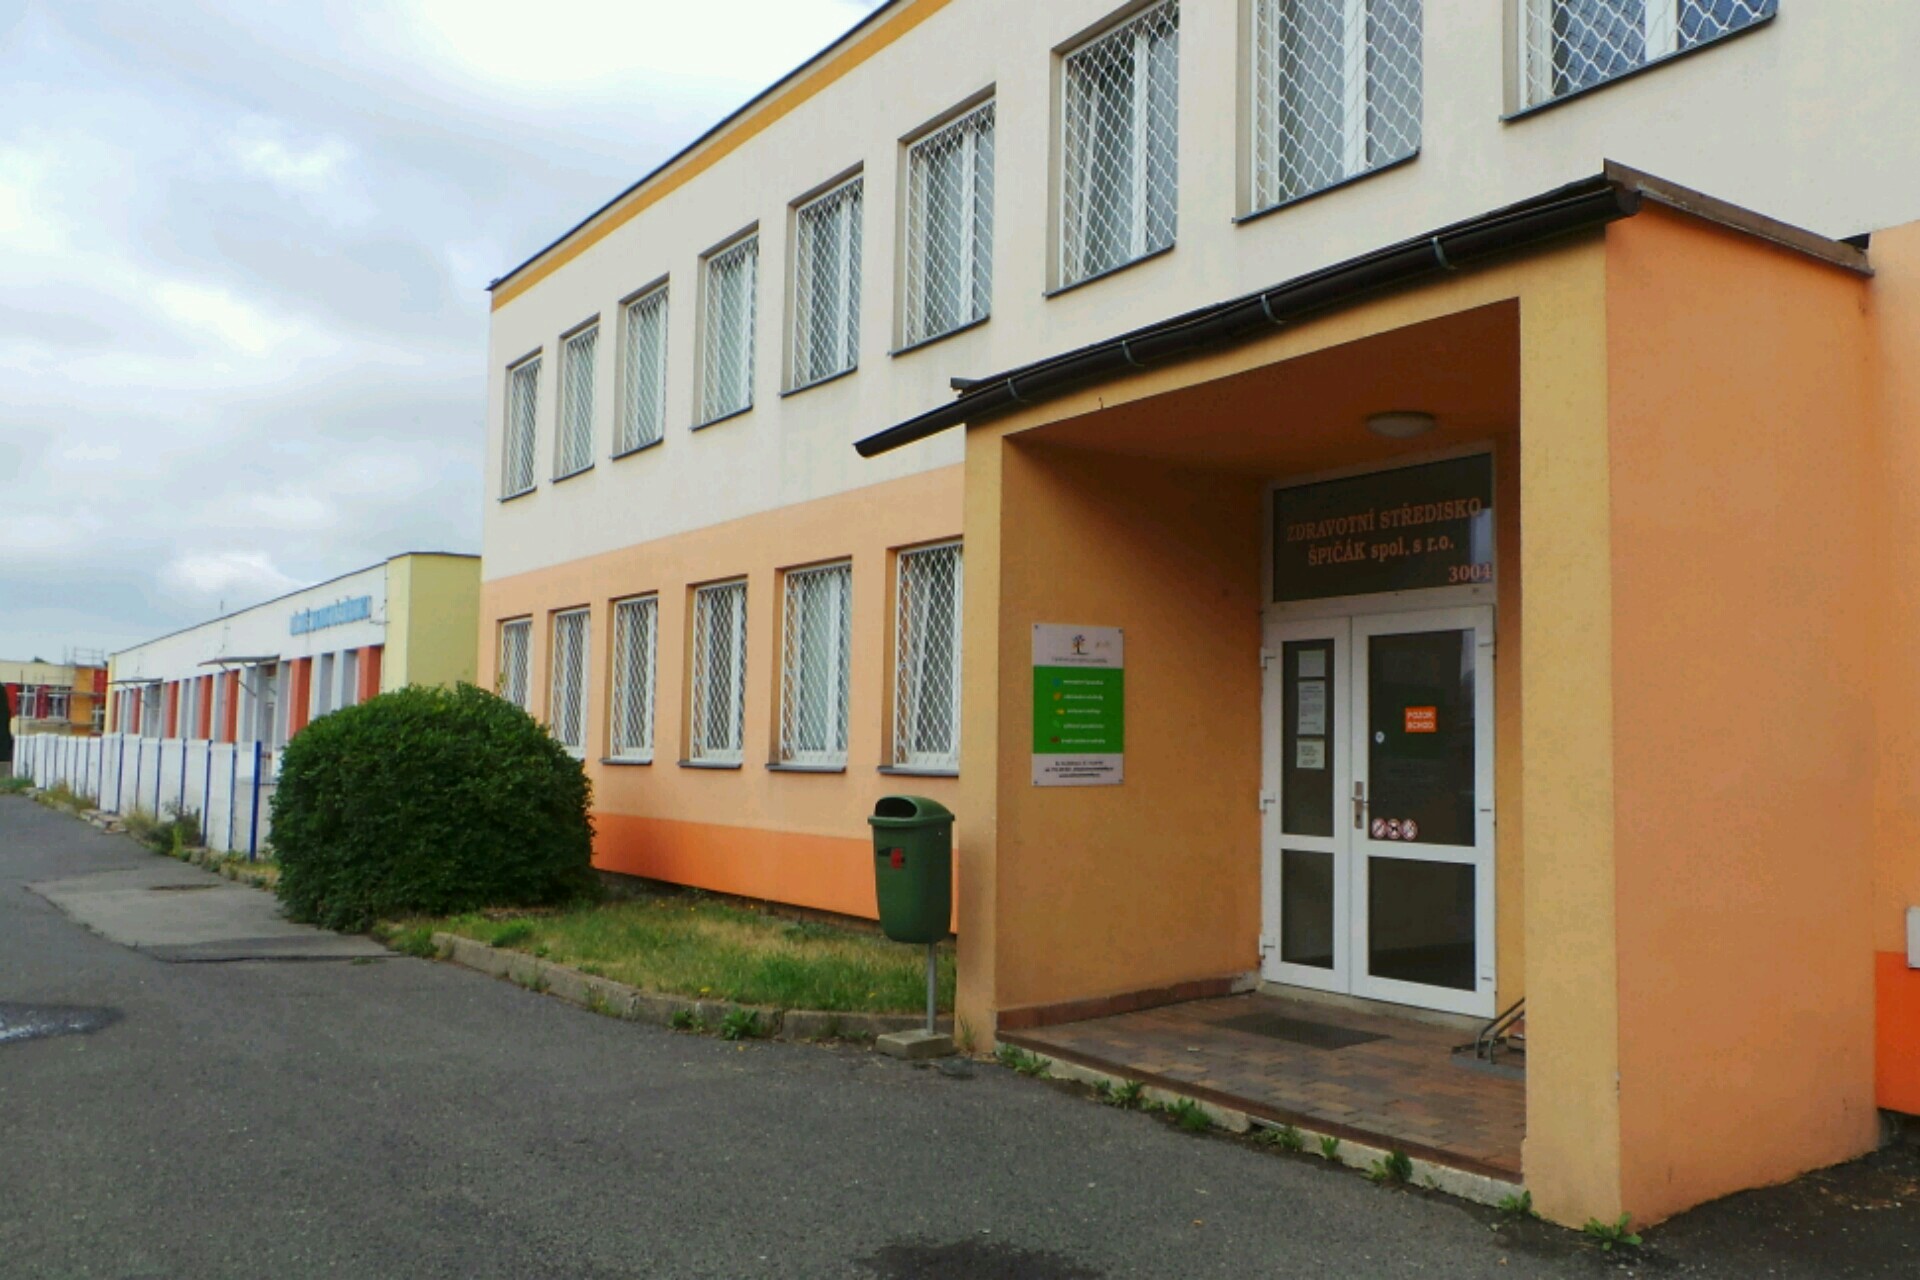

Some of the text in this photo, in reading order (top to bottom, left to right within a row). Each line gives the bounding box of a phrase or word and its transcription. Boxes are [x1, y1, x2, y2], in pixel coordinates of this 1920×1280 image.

[1287, 498, 1482, 542] ZDRAVOTNÍ STŘEDISKO
[1308, 535, 1455, 566] ŠPIČÁK spol. s r.o.
[1449, 563, 1492, 582] 3004
